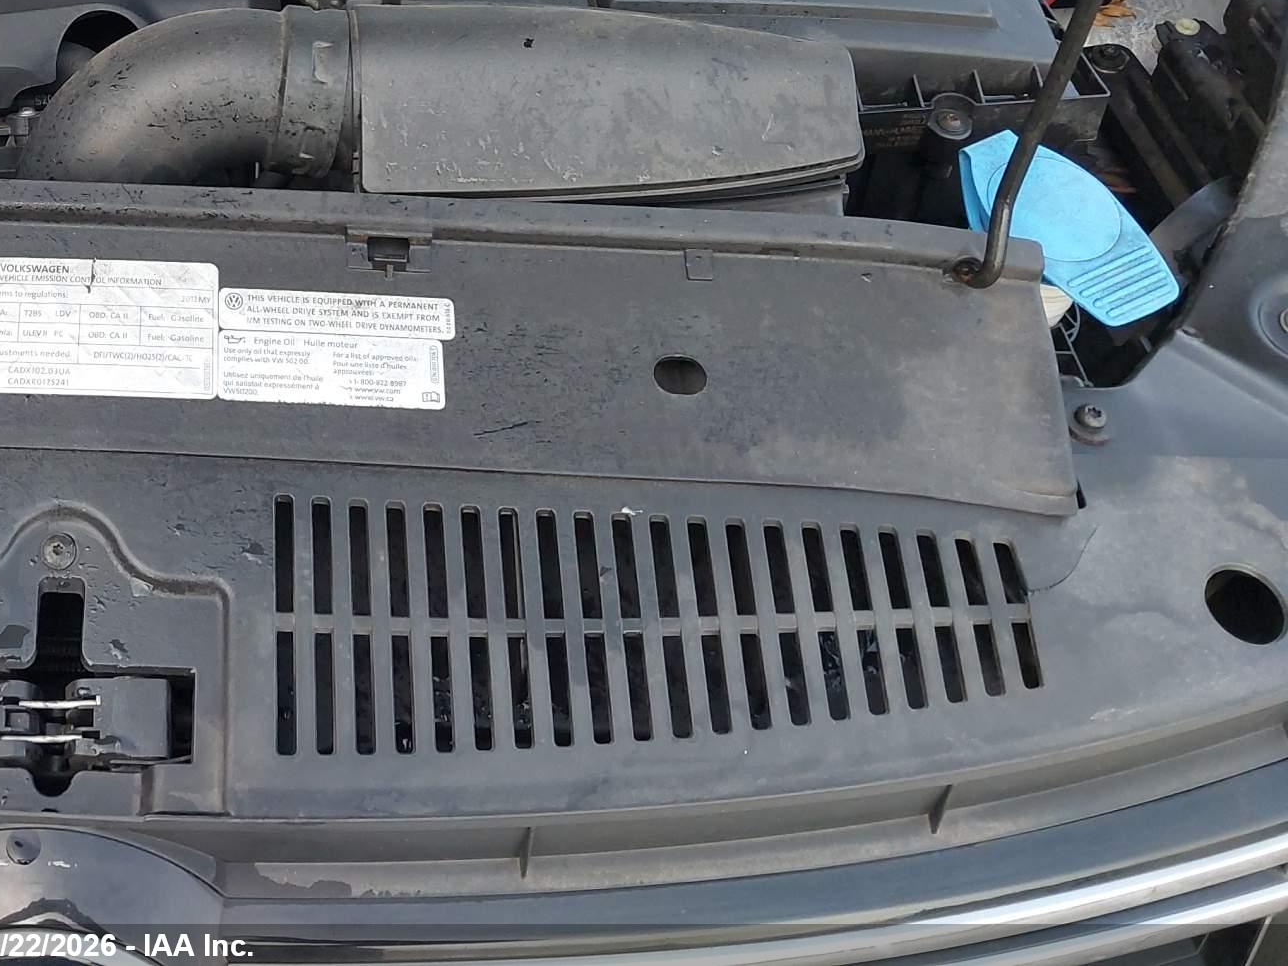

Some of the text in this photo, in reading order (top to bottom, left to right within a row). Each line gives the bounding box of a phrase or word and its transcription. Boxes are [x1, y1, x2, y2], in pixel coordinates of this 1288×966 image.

[0, 264, 70, 274] VOLKSWAGEN
[0, 274, 29, 282] VEHICLE
[31, 275, 68, 283] EMISSION
[107, 277, 162, 286] INFORMATION
[247, 294, 439, 311] THIS VEHICLE IS EQUIPPED WITH A PERMANENT
[170, 314, 204, 323] Gasoline
[247, 306, 440, 322] ALL-WHEEL DRIVE SYSTEM AND IS EXEMPT FROM
[263, 317, 292, 325] TESTING
[309, 320, 352, 329] TWO-WHEEL
[356, 321, 377, 330] DRIVE
[380, 323, 444, 334] DYNAMOMETERS.
[170, 334, 205, 343] Gasoline
[253, 336, 358, 349] Engine Oil Huile moteur
[263, 348, 278, 356] that
[279, 350, 311, 358] expressly
[350, 352, 362, 360] list
[372, 354, 403, 363] approved
[223, 356, 253, 364] complies
[333, 360, 349, 368] Pour
[364, 361, 379, 369] liste
[250, 373, 291, 382] uniquement
[293, 373, 302, 381] de
